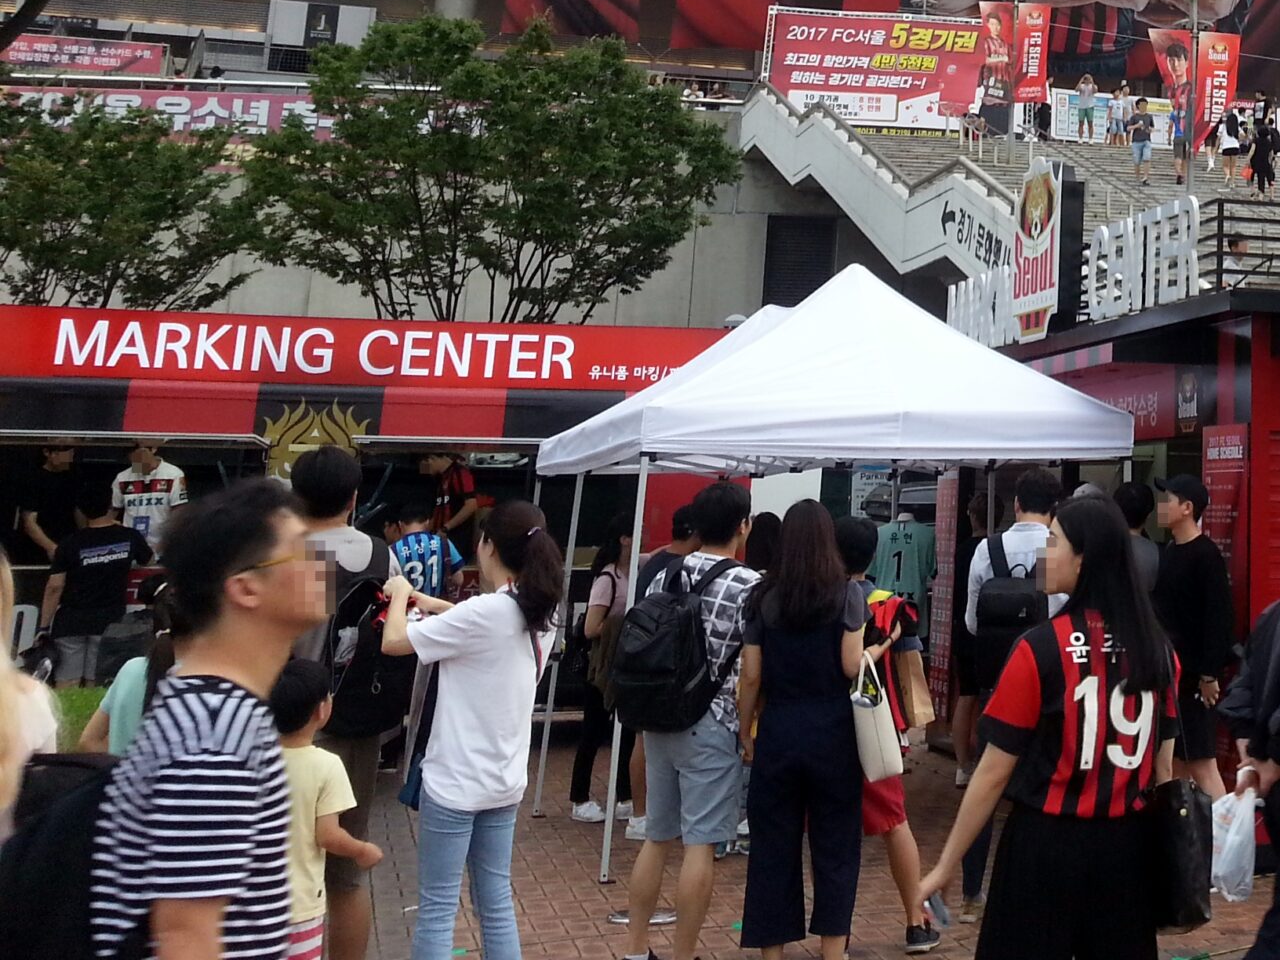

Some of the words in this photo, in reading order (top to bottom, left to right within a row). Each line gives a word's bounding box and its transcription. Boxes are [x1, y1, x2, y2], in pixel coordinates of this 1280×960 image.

[787, 25, 828, 42] 2017
[831, 28, 886, 46] FC서울
[783, 52, 821, 66] 최고의
[823, 54, 870, 69] 할인가격
[870, 53, 897, 71] 4만
[898, 55, 938, 73] 5천원
[790, 71, 825, 85] 원하는
[829, 72, 864, 87] 경기만
[1213, 70, 1228, 86] FC
[1014, 225, 1055, 299] Seoul
[1089, 195, 1200, 323] CENTER
[52, 318, 335, 375] MARKING
[358, 329, 576, 380] CENTER
[588, 365, 629, 381] 유니폼
[82, 551, 129, 566] patagonia
[892, 551, 903, 582] 1
[404, 555, 439, 591] 31
[1074, 676, 1154, 770] 19
